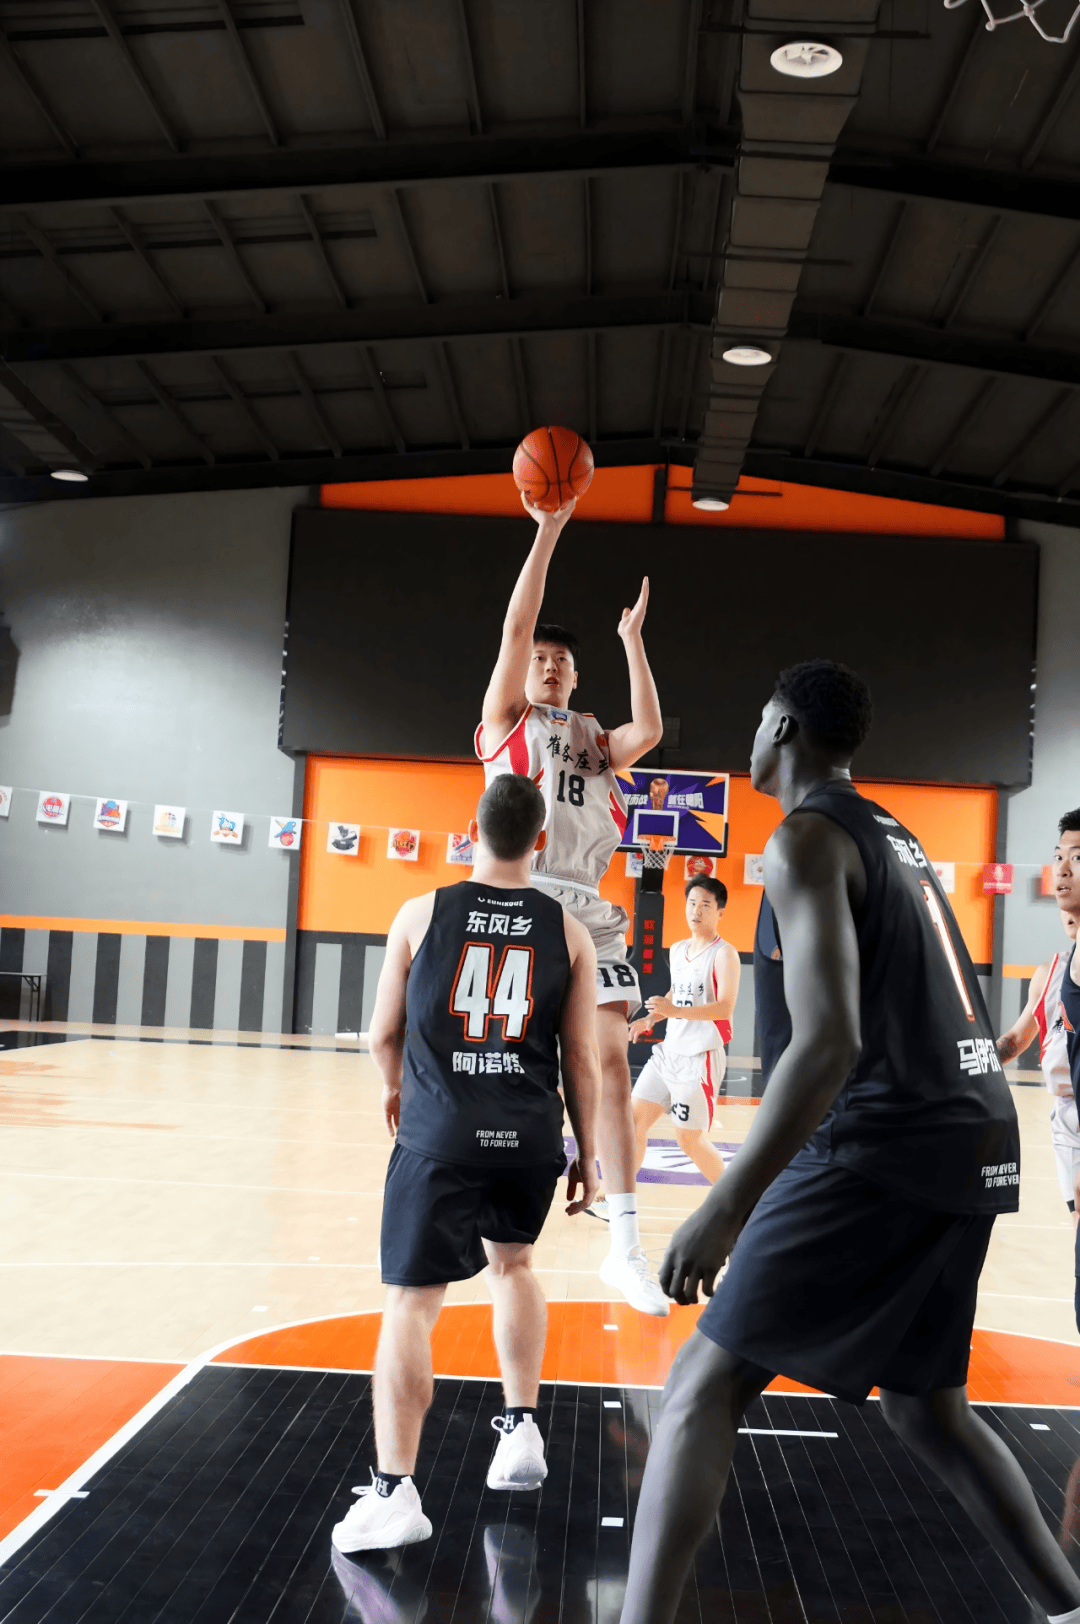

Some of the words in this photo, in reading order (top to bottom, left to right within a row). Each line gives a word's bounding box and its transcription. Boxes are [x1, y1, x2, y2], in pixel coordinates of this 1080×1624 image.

[557, 769, 585, 807] 18
[465, 910, 533, 936] 东风乡
[920, 880, 976, 1022] 1
[597, 964, 636, 987] 18
[449, 941, 535, 1042] 44
[452, 1051, 526, 1075] 阿诺特
[956, 1037, 1002, 1076] 马伊尔
[476, 1129, 495, 1139] FROM
[496, 1130, 518, 1139] NEVER
[480, 1138, 489, 1148] TO
[490, 1139, 520, 1148] FOREVER
[980, 1165, 998, 1177] FROM
[998, 1162, 1018, 1175] NEVER
[984, 1177, 993, 1189] TO
[503, 1414, 515, 1430] H
